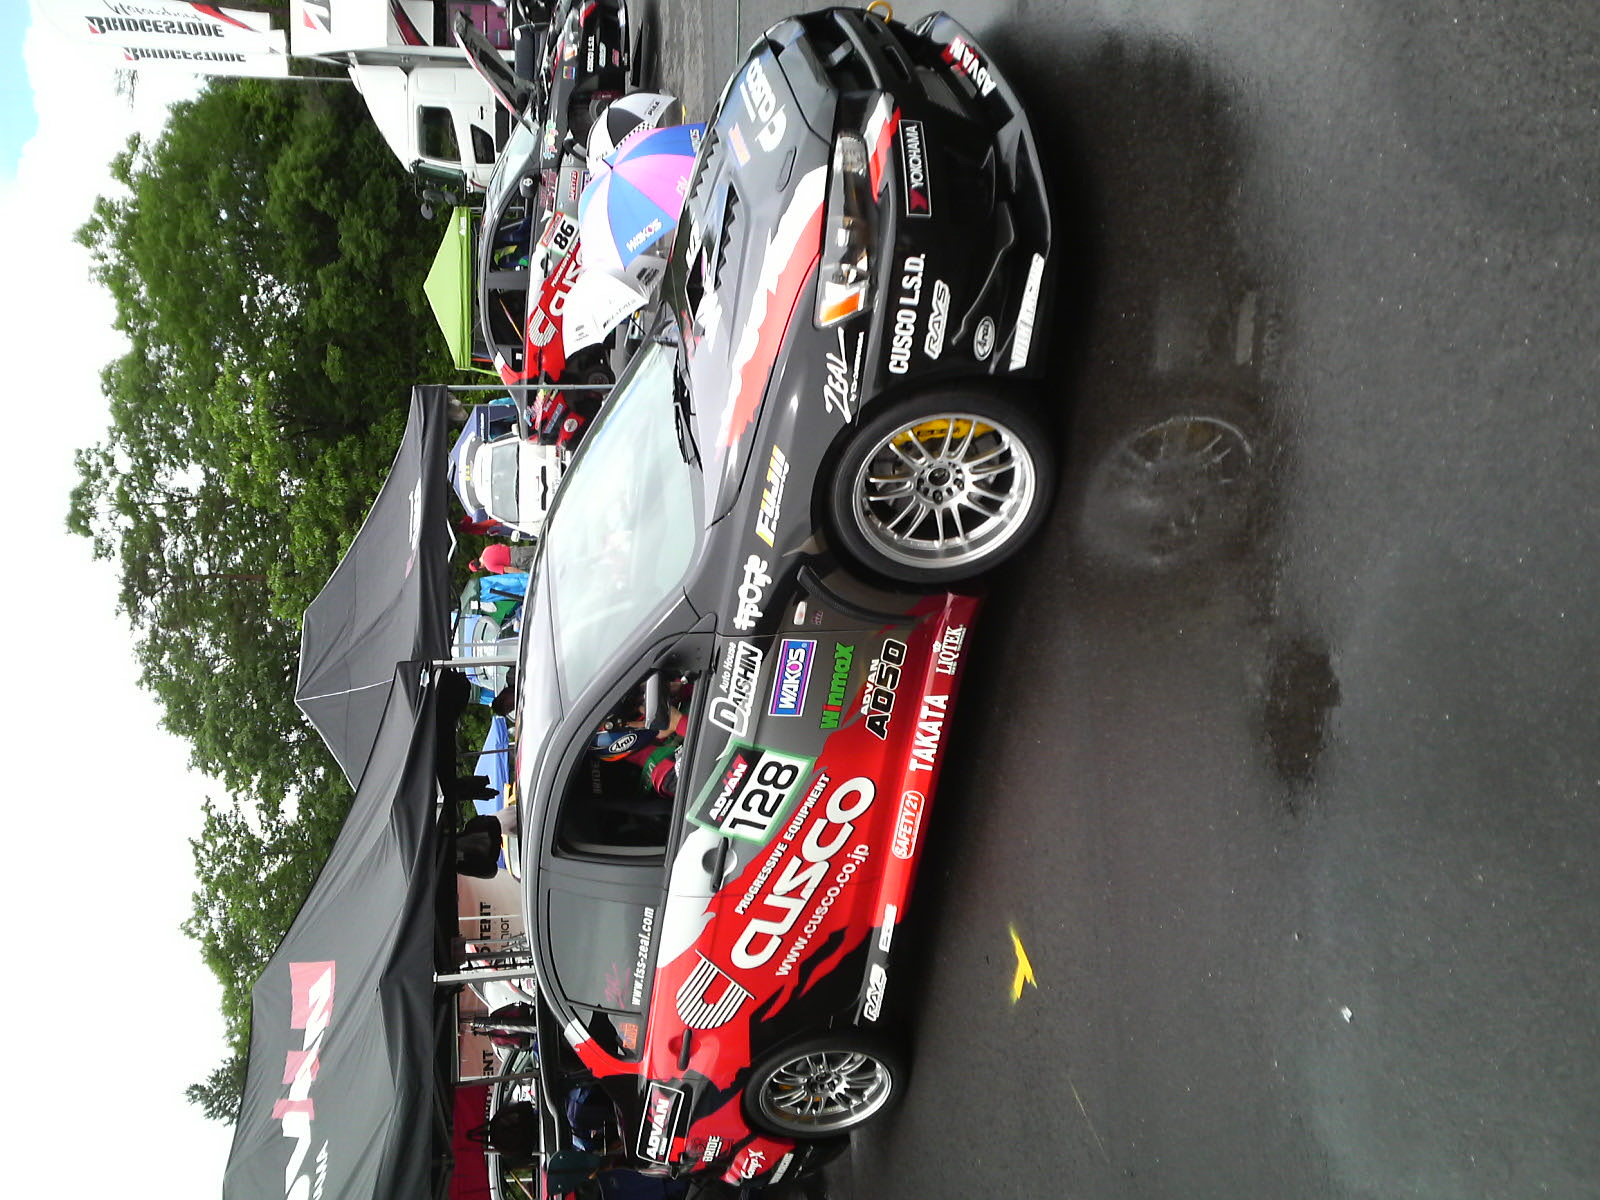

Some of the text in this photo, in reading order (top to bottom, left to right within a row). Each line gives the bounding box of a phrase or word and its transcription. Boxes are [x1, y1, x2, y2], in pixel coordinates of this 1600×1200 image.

[949, 36, 997, 97] ADVAN
[905, 125, 925, 188] YOKOHAMA
[553, 220, 575, 250] 86
[888, 253, 925, 374] CUSCO L.S.D.
[925, 280, 950, 358] RAYS
[823, 326, 852, 423] ZEAL
[719, 641, 736, 693] Auto House
[934, 624, 963, 676] LIQTEK
[708, 640, 763, 737] DAISHIN
[860, 658, 880, 715] ADVAN
[908, 694, 949, 772] TAKATA
[709, 762, 748, 820] ADVAN
[728, 760, 799, 830] 128
[730, 776, 876, 969] CUSCO
[734, 773, 830, 915] PROGRESSIVE EQUIPMENT
[775, 844, 870, 976] www.cusco.co.jp
[631, 906, 655, 1006] www.tss-zeal.com
[646, 1098, 670, 1159] ADVAN
[702, 1135, 720, 1162] BRIDE
